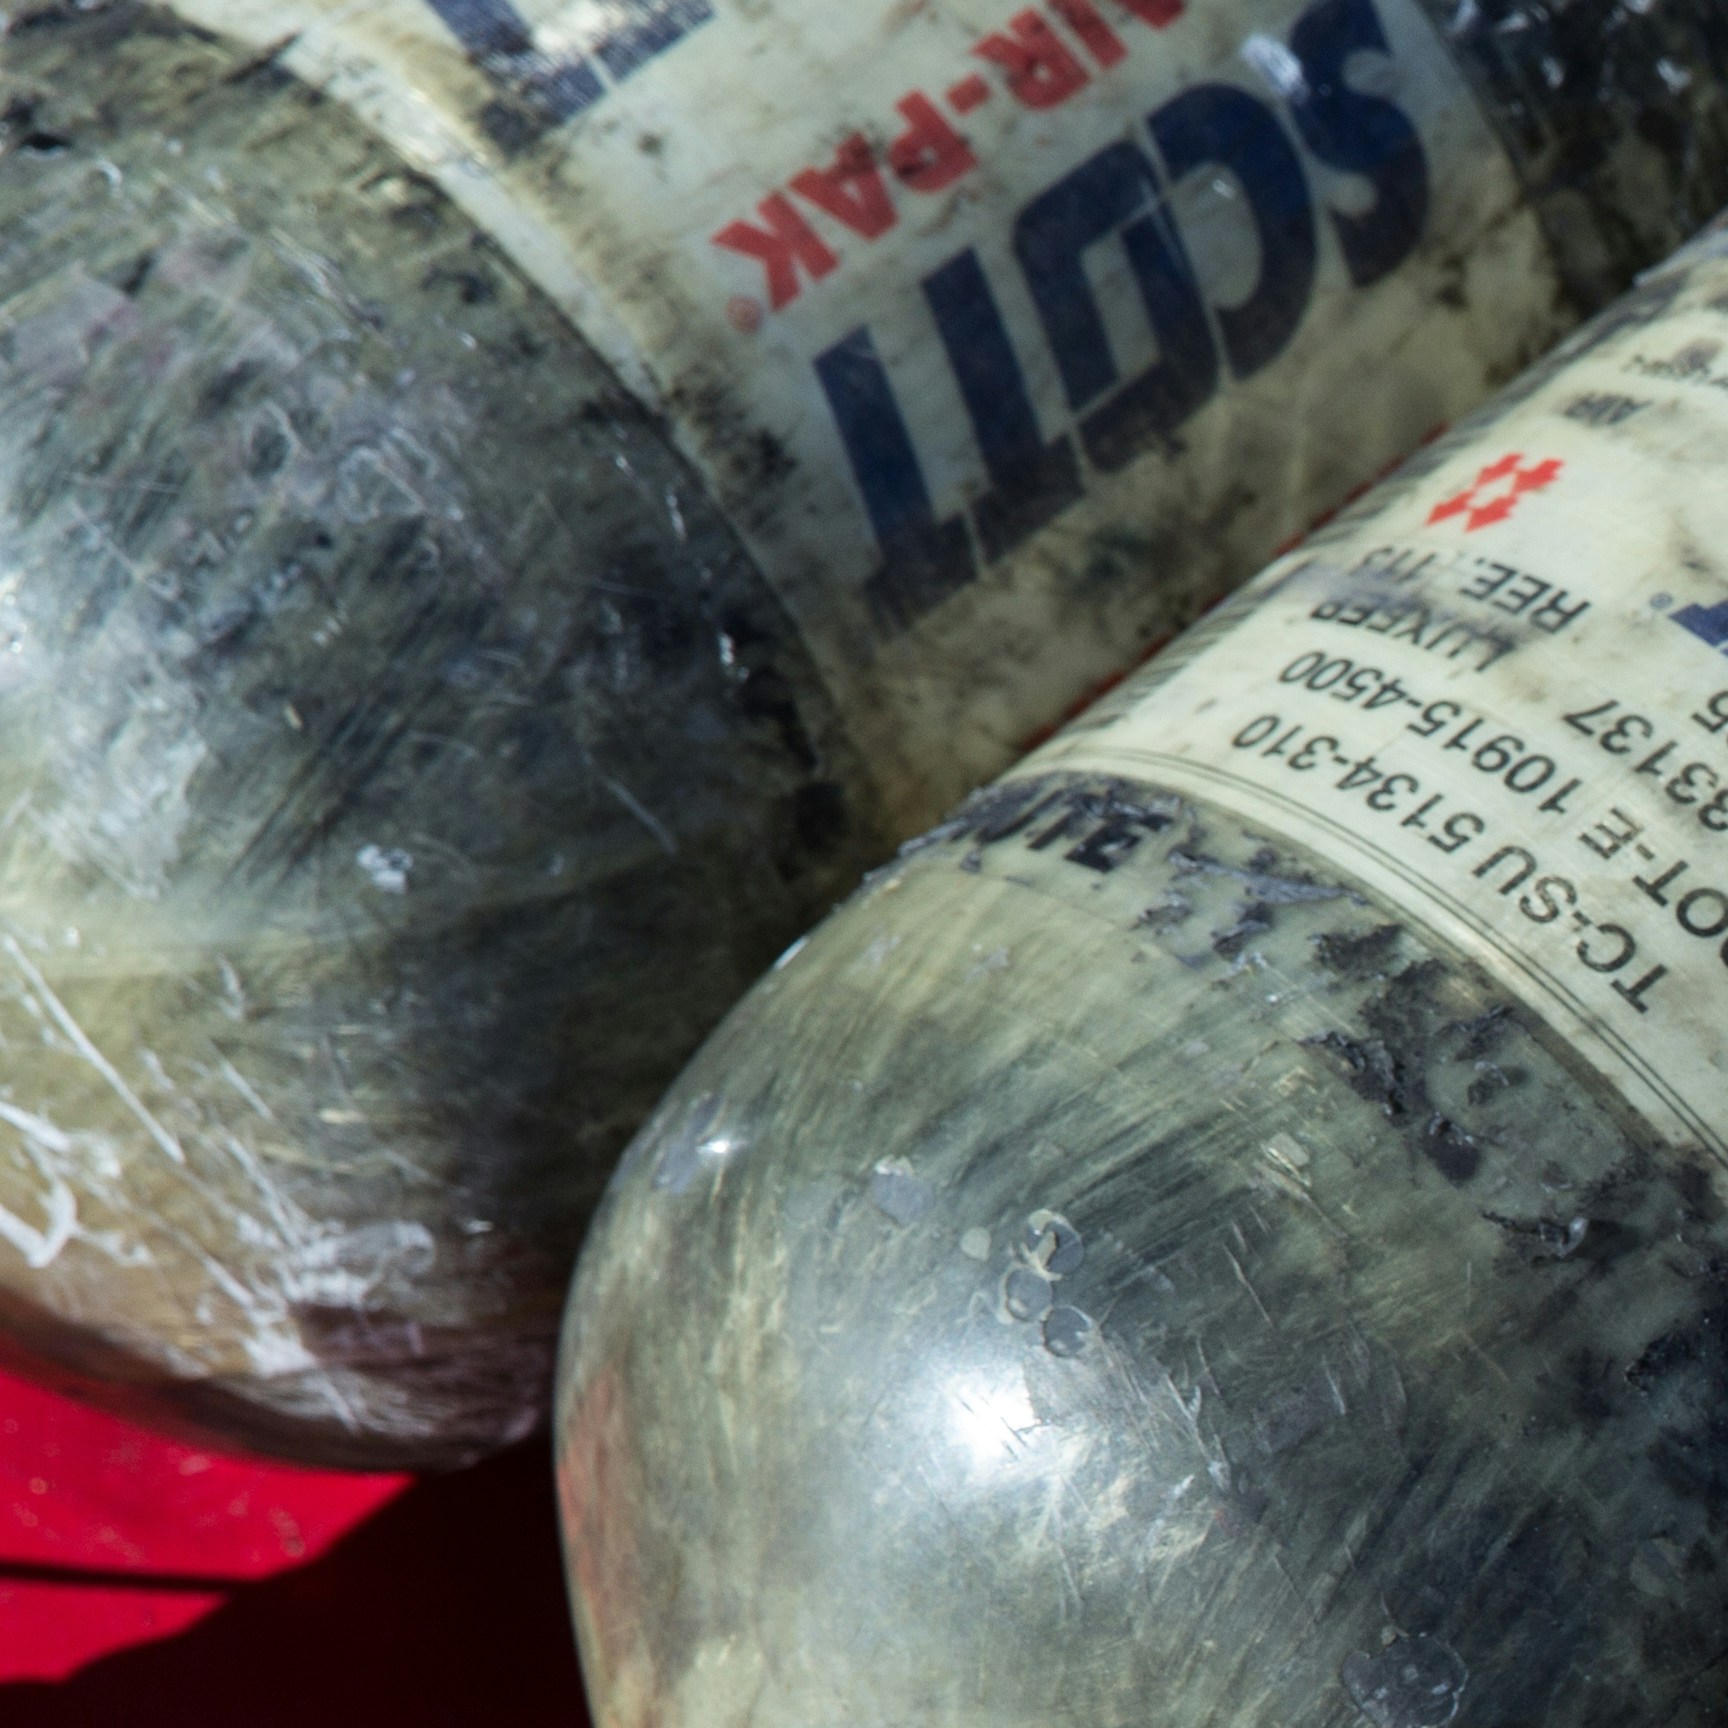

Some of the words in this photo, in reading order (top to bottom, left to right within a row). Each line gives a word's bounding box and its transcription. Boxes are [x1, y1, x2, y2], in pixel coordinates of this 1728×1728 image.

[712, 0, 1185, 313] IR-PAK
[812, 0, 1432, 638] SCOTT
[1459, 563, 1594, 635] REE.
[1231, 712, 1485, 855] 5134-310
[1277, 648, 1584, 817] 10915-4500
[1472, 844, 1670, 1015] TC-SU
